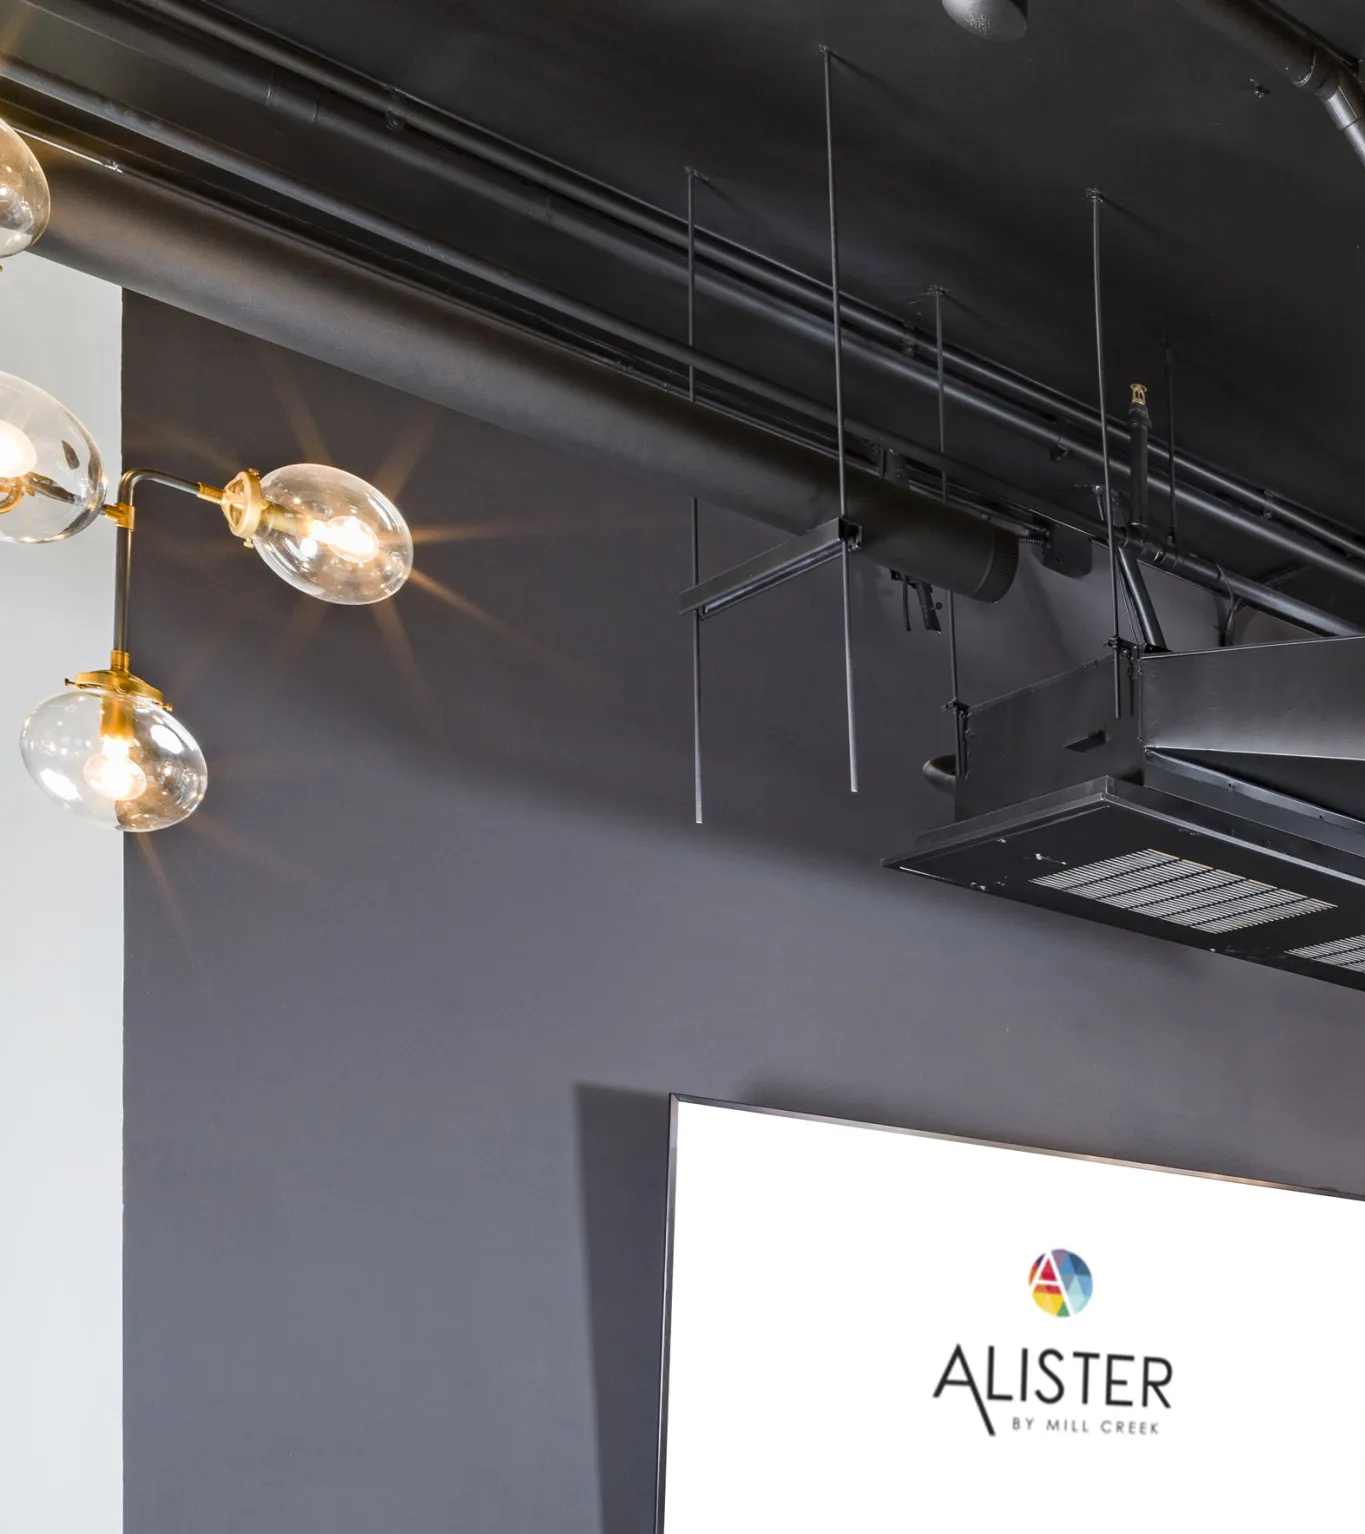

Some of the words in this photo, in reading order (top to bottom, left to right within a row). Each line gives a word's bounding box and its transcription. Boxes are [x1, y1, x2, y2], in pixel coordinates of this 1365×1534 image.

[932, 1343, 1173, 1437] ALISTER
[1012, 1417, 1034, 1431] BY
[1046, 1419, 1089, 1433] MILL
[1100, 1420, 1159, 1435] CREEK
